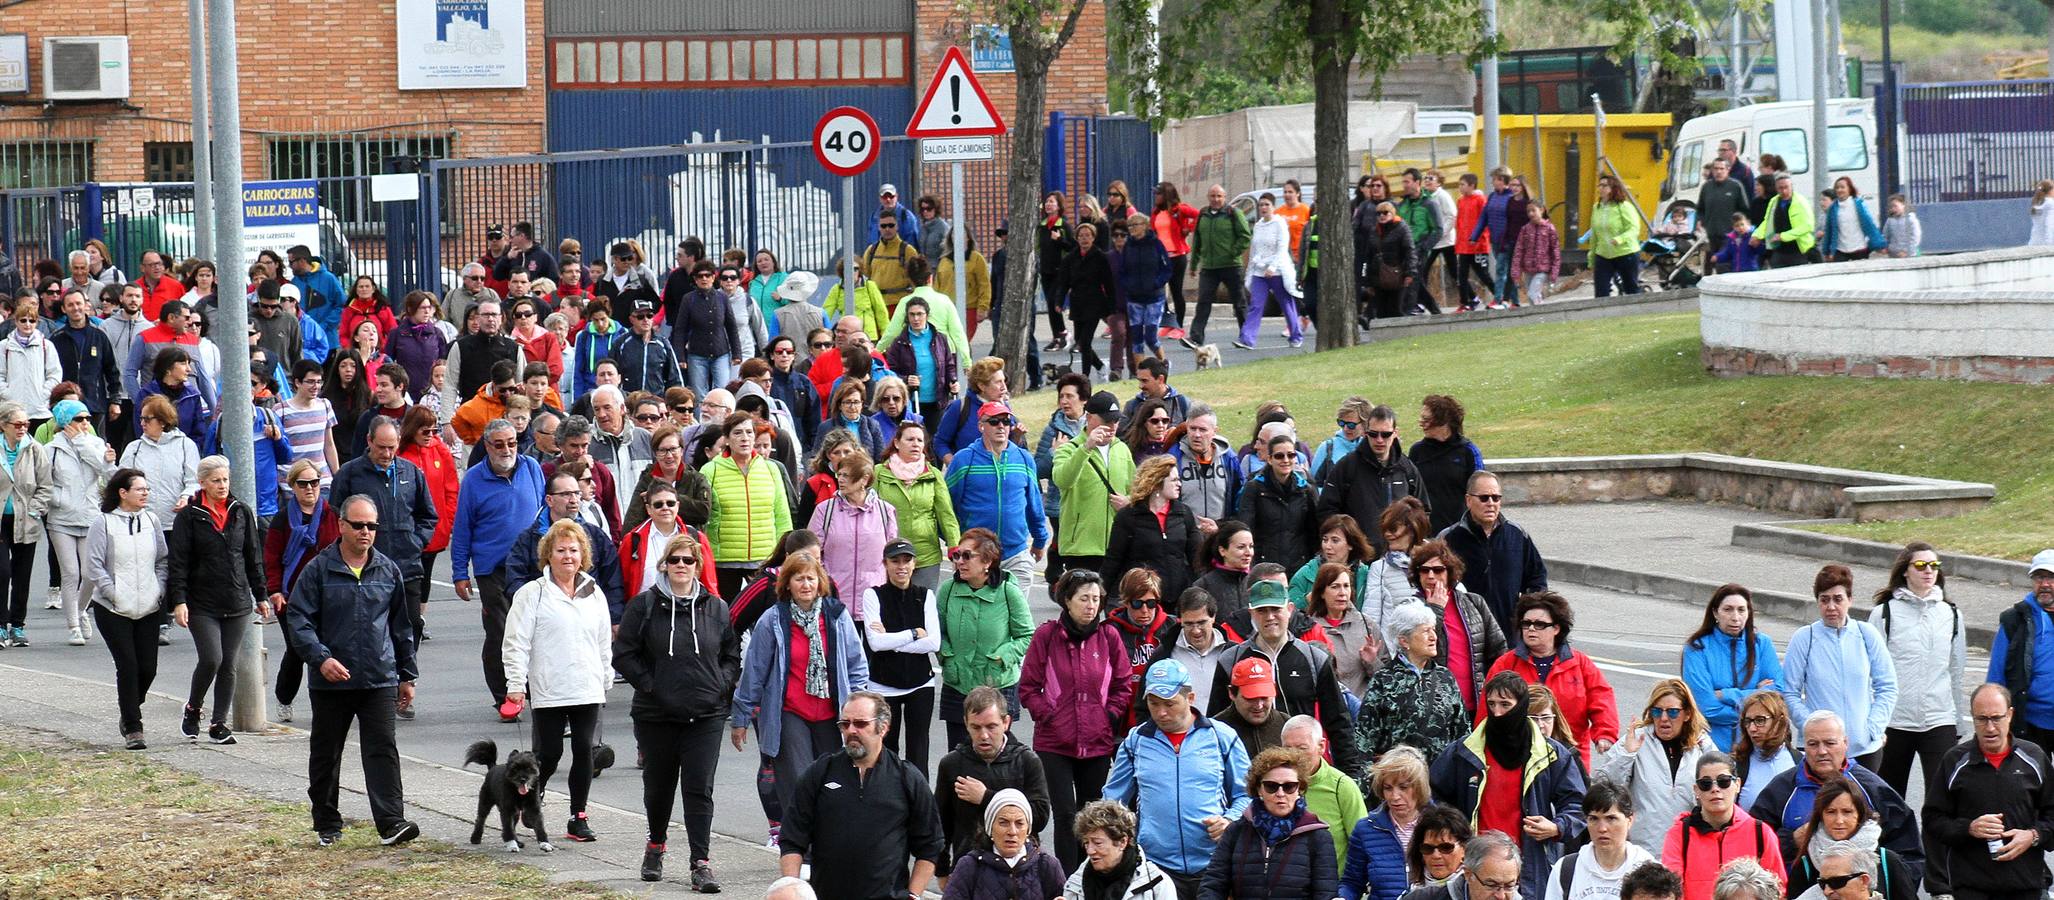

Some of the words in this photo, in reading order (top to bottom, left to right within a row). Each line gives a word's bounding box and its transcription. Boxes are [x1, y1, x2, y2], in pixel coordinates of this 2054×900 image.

[825, 130, 866, 153] 40
[924, 144, 947, 154] SALIDA
[948, 144, 957, 154] DE
[958, 143, 991, 153] CAMIONES
[242, 187, 315, 202] CARROCERIAS
[245, 204, 292, 217] VALLEJO,
[294, 203, 314, 216] S.A.
